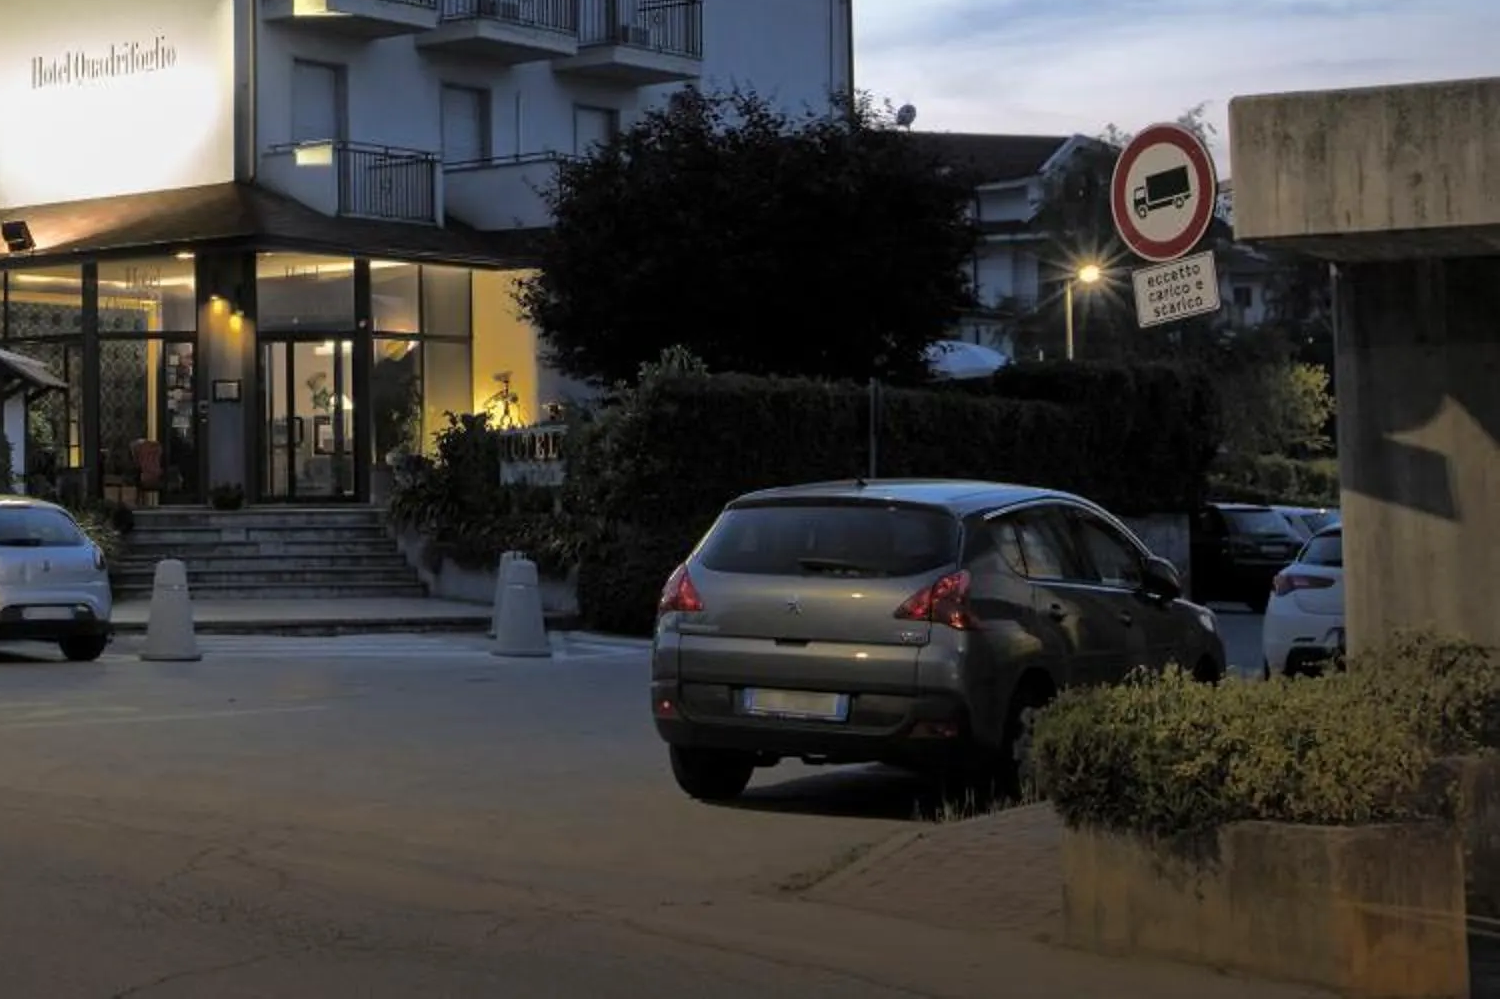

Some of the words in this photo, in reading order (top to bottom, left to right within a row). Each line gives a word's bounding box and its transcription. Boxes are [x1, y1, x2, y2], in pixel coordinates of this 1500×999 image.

[31, 52, 70, 89] Hotel
[74, 35, 177, 83] Quadrifoglio
[1147, 264, 1201, 288] eccetto
[1148, 283, 1191, 302] carico
[1195, 280, 1204, 290] e
[1153, 296, 1203, 318] scarico
